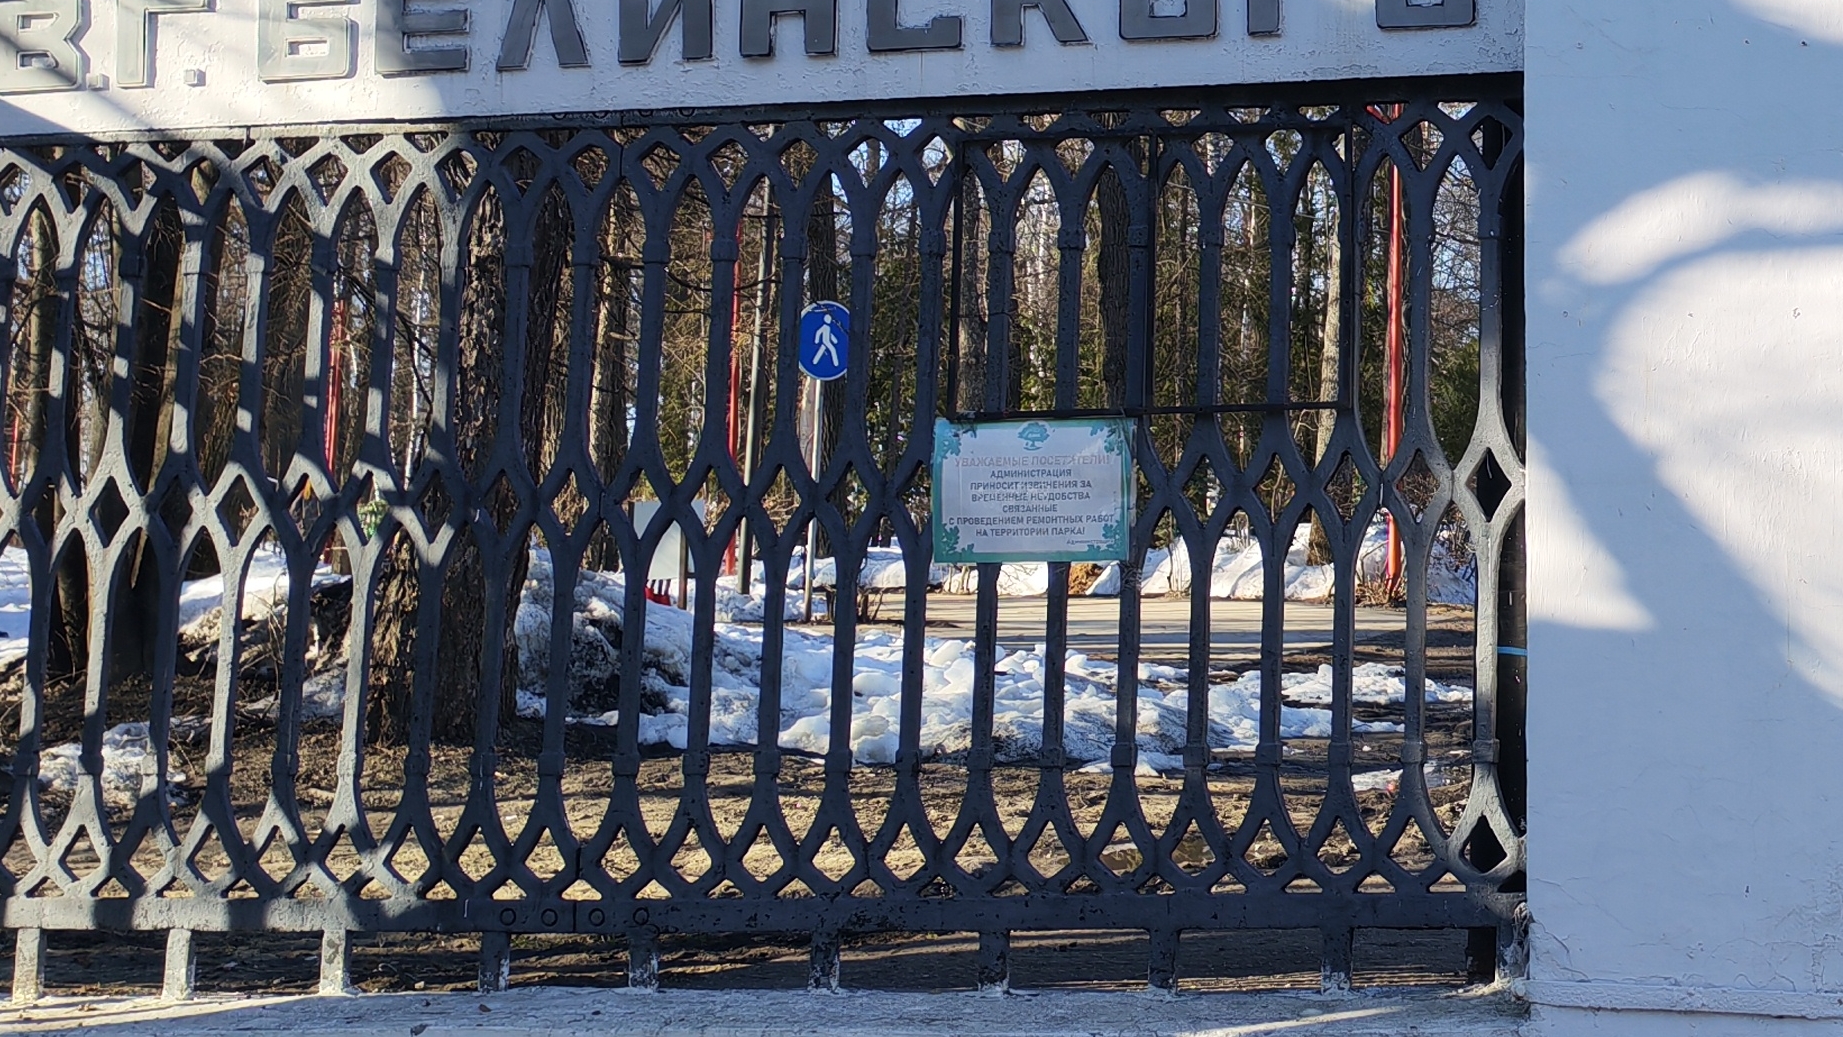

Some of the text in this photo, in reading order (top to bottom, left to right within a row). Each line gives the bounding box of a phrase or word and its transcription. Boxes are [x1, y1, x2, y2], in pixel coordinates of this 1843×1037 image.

[955, 456, 1029, 467] УВАЖАЕМЫЕ
[990, 469, 1072, 479] АДМИНИСТРАЦИЯ
[970, 482, 1018, 491] ПРИНОСИТ
[1079, 480, 1092, 489] ЗА
[1030, 492, 1091, 502] НЕУДОБСТВА
[1002, 504, 1058, 513] СВЯЗАННЫЕ
[949, 514, 1114, 526] С ПРОВЕДЕНИЕМ РЕМОНТНЫХ РАБОТ
[976, 526, 1085, 537] НА ТЕРРИТОРИИ ПАРКА!
